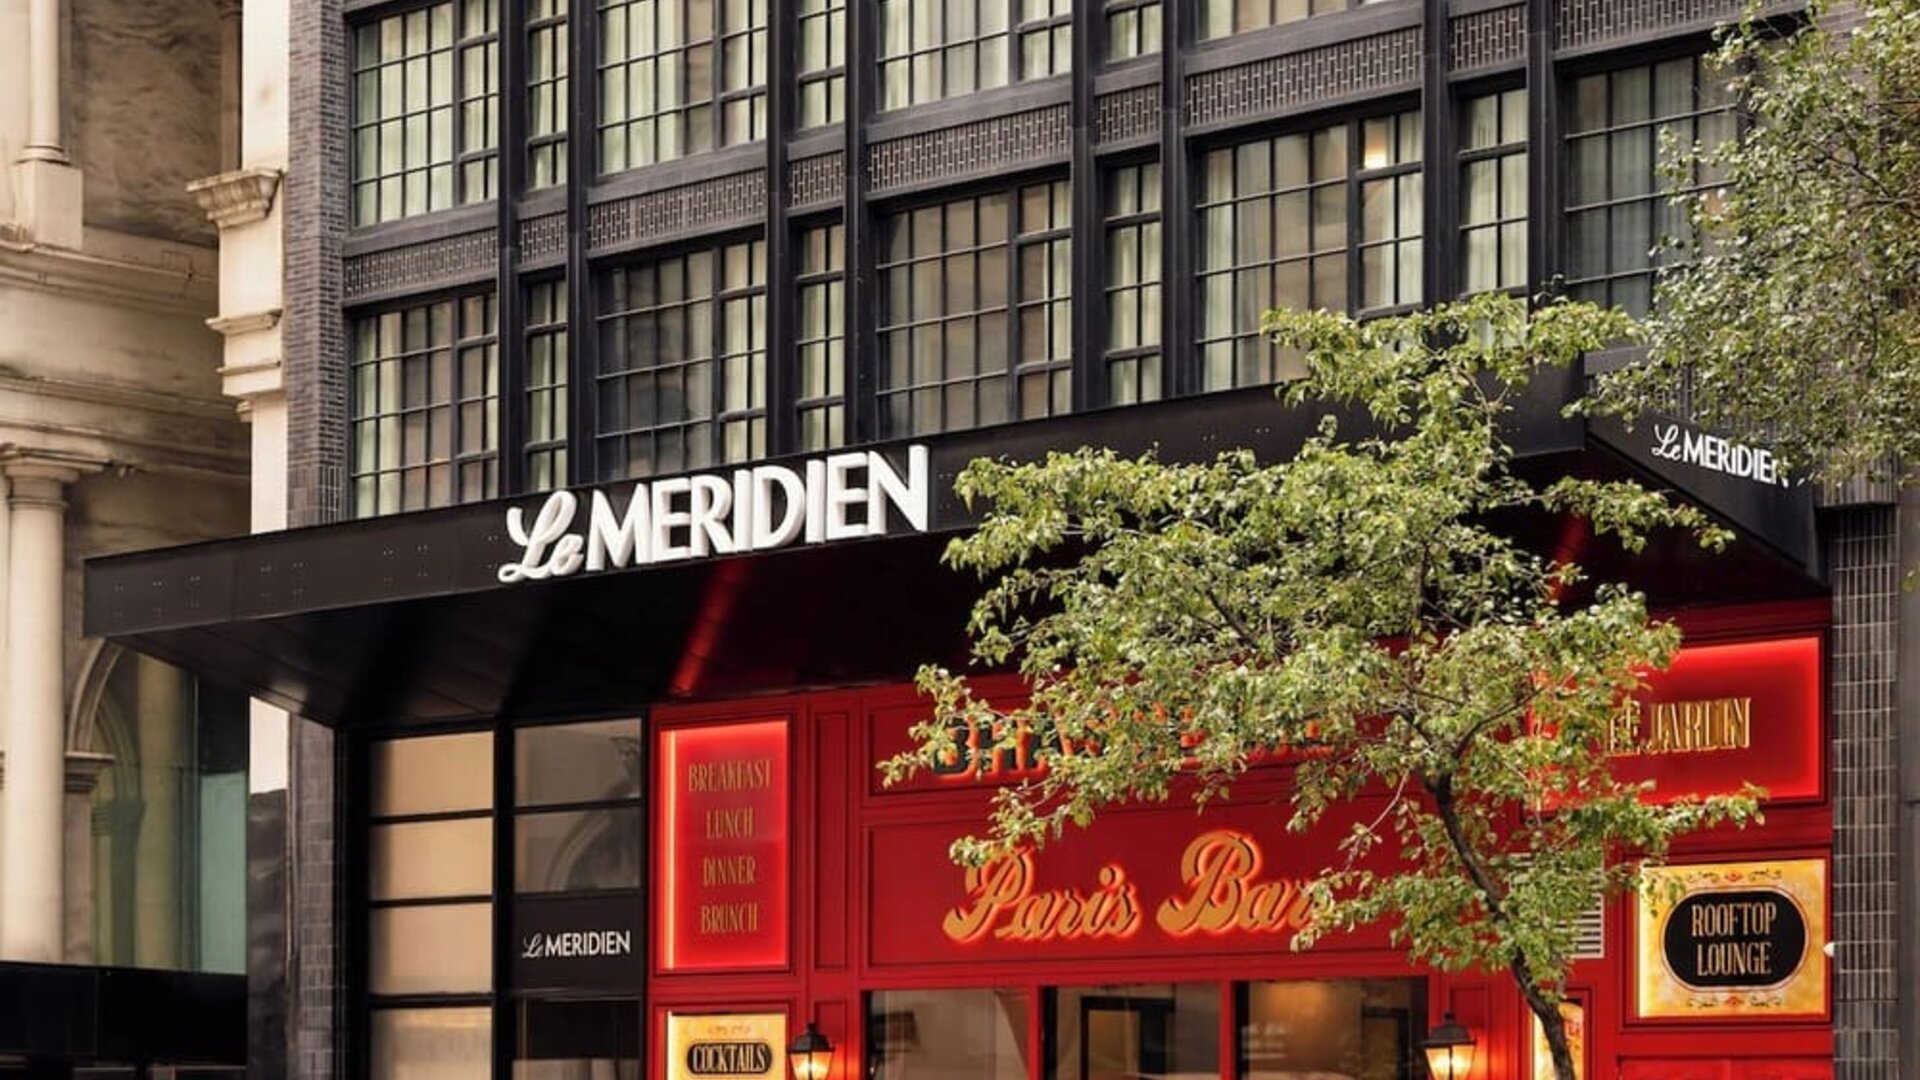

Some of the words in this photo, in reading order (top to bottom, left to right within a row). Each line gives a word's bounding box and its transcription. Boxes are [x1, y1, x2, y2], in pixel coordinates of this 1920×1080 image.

[1651, 424, 1682, 461] Le
[498, 490, 584, 583] Le
[586, 444, 929, 571] MERIDIEN
[1646, 698, 1751, 755] JARDIN
[688, 759, 771, 792] BREAKFAST
[706, 807, 754, 839] LUNCH
[703, 855, 756, 887] DINNER
[943, 847, 1140, 940] Paris
[701, 902, 758, 934] BRUNCH
[1691, 902, 1777, 937] ROOFTOP
[522, 932, 543, 958] Le
[545, 930, 630, 957] MERIDIEN
[1697, 941, 1772, 977] LOUNGE
[692, 1044, 766, 1073] COCKTAILS
